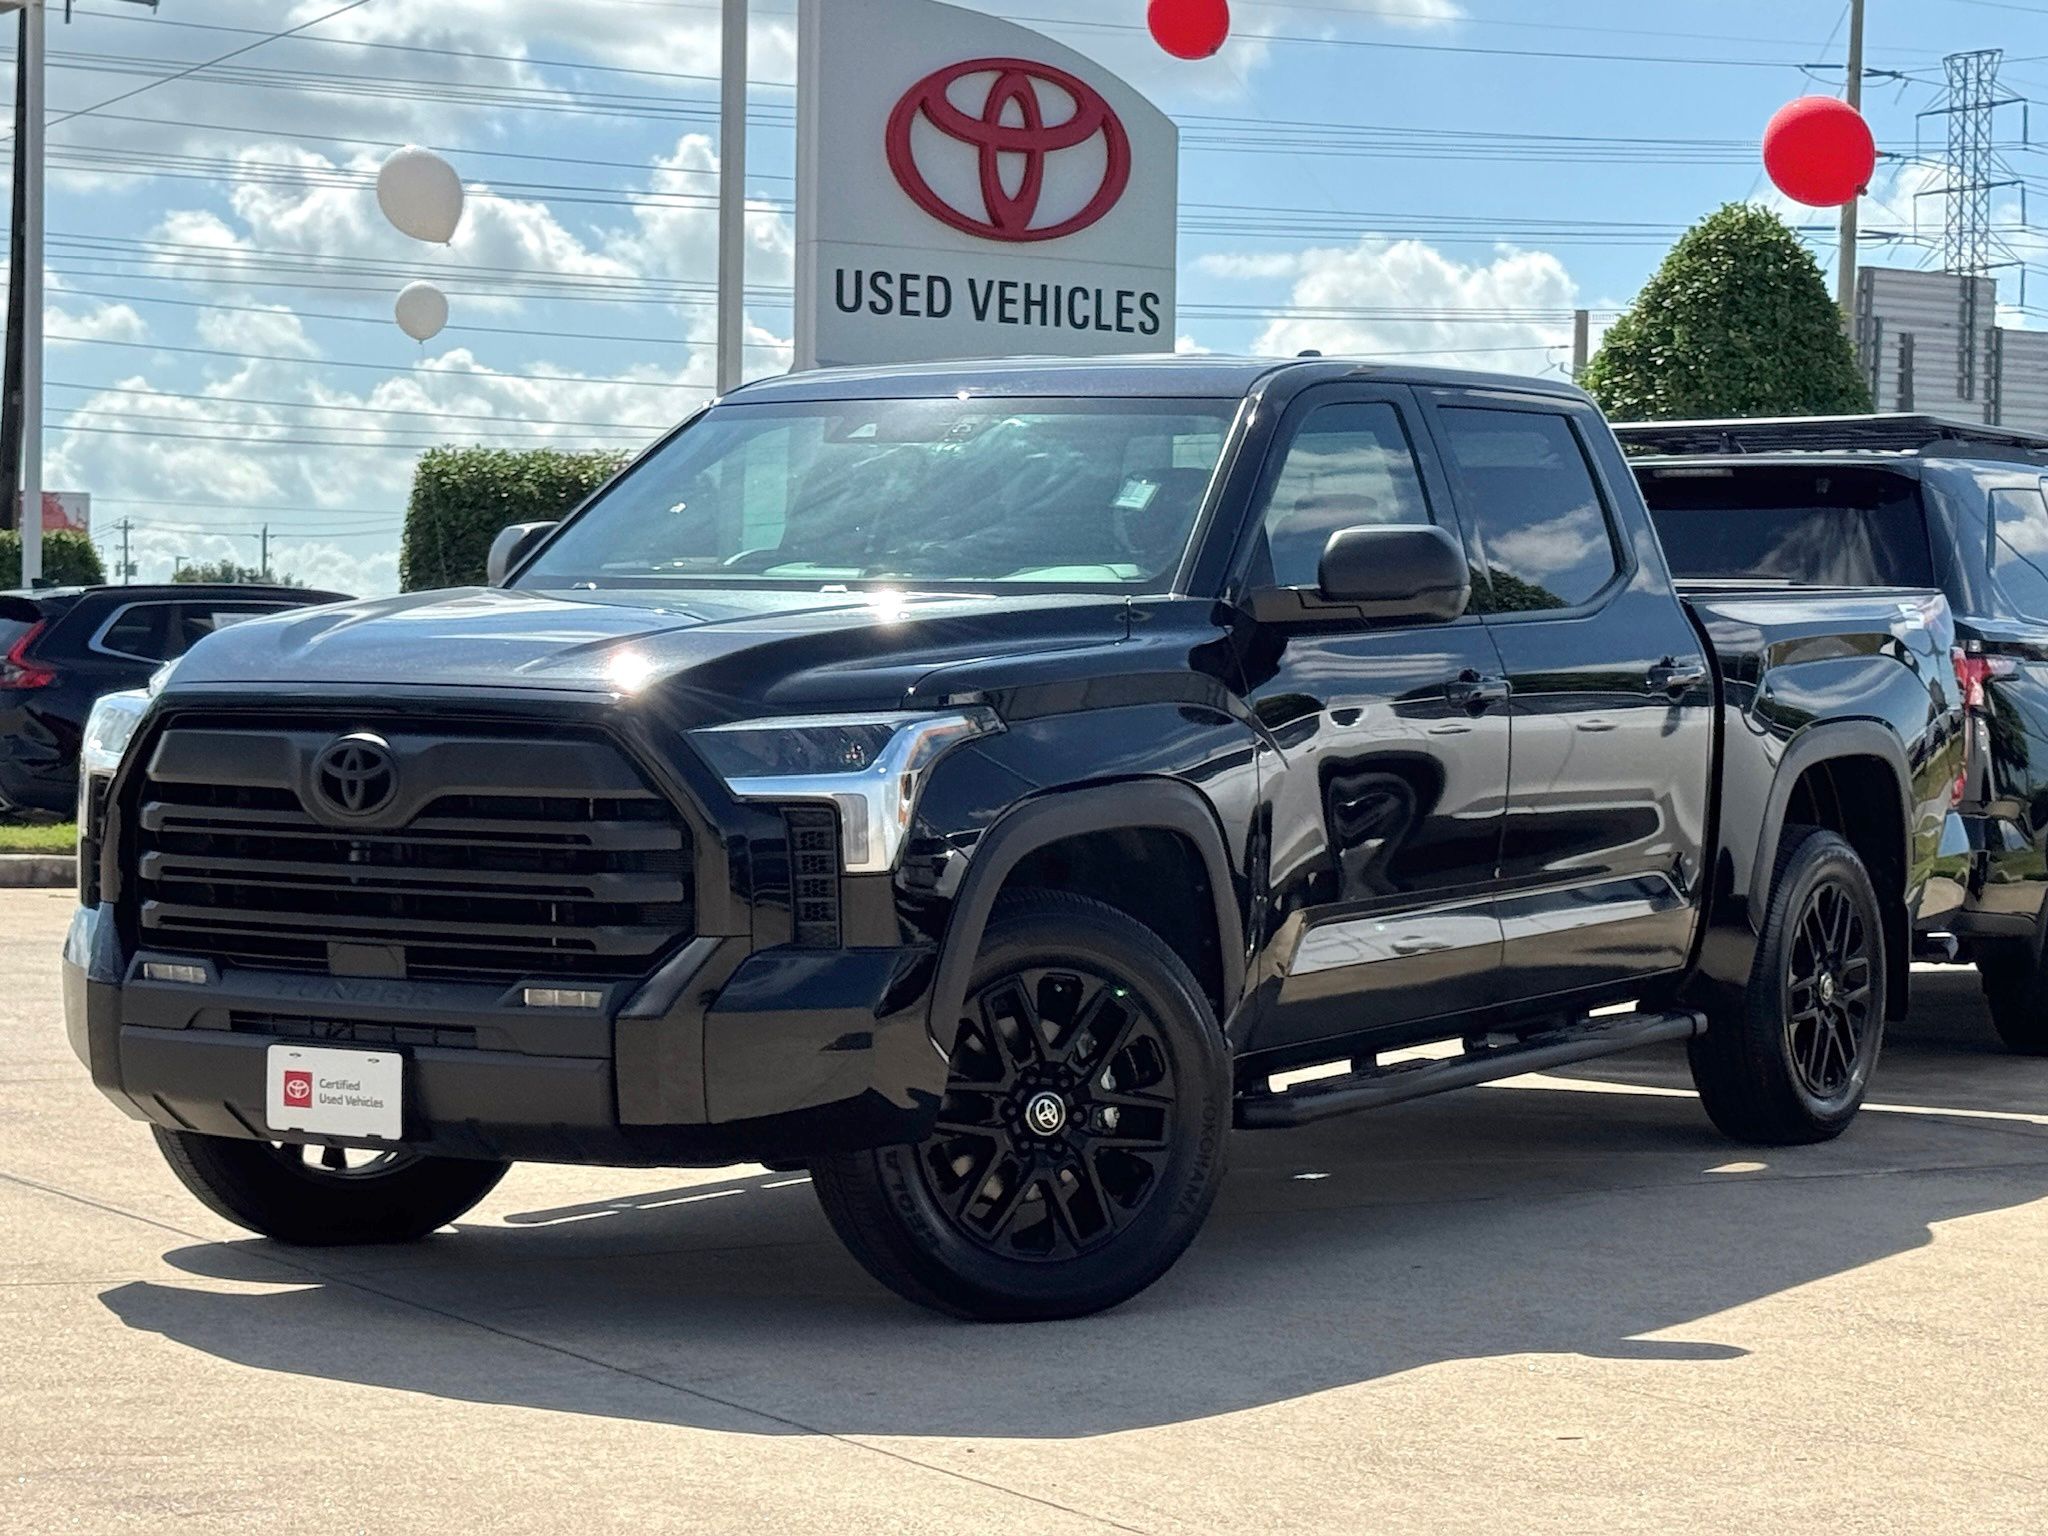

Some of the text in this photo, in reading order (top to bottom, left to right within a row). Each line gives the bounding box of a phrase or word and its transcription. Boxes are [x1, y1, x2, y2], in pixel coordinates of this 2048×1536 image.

[835, 268, 1160, 335] USED VEHICLES
[319, 1078, 361, 1091] Certified
[319, 1093, 384, 1109] Used Vehicles
[1172, 1095, 1217, 1214] YOKOHAMA
